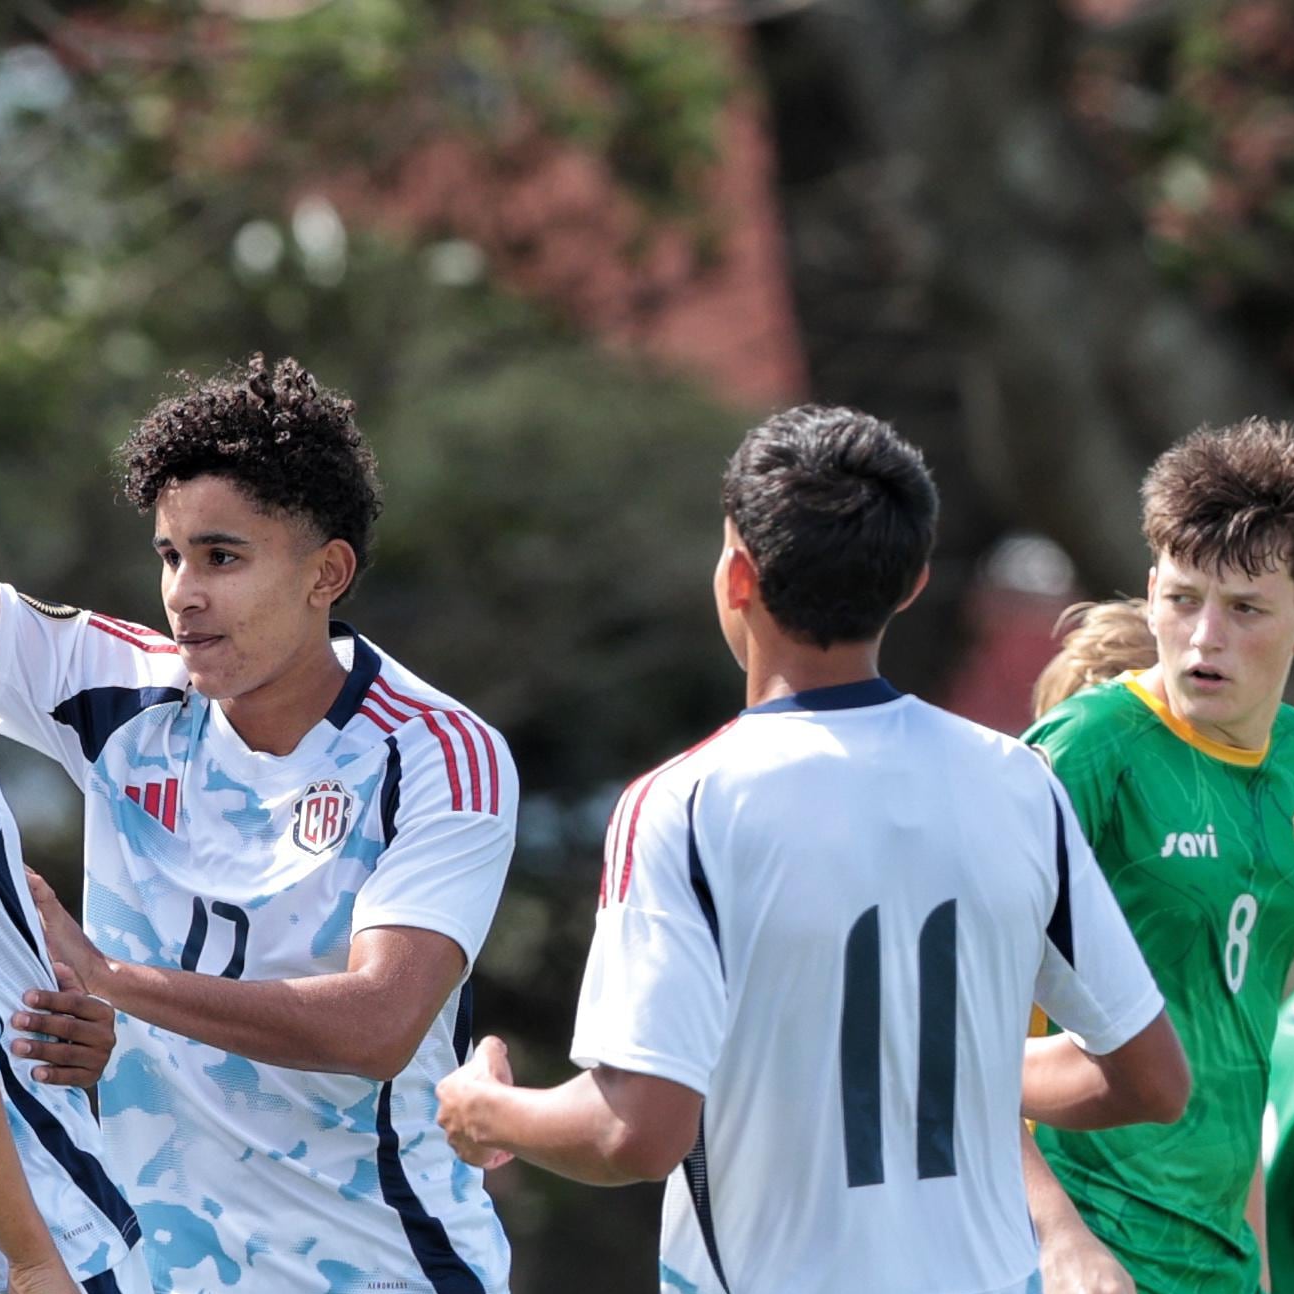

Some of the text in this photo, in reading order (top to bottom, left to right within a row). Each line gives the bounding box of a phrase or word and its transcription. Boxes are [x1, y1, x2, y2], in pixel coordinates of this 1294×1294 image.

[304, 796, 339, 844] CR
[1161, 824, 1218, 858] savi
[181, 896, 249, 980] 17
[1225, 893, 1257, 994] 8
[840, 898, 957, 1187] 11
